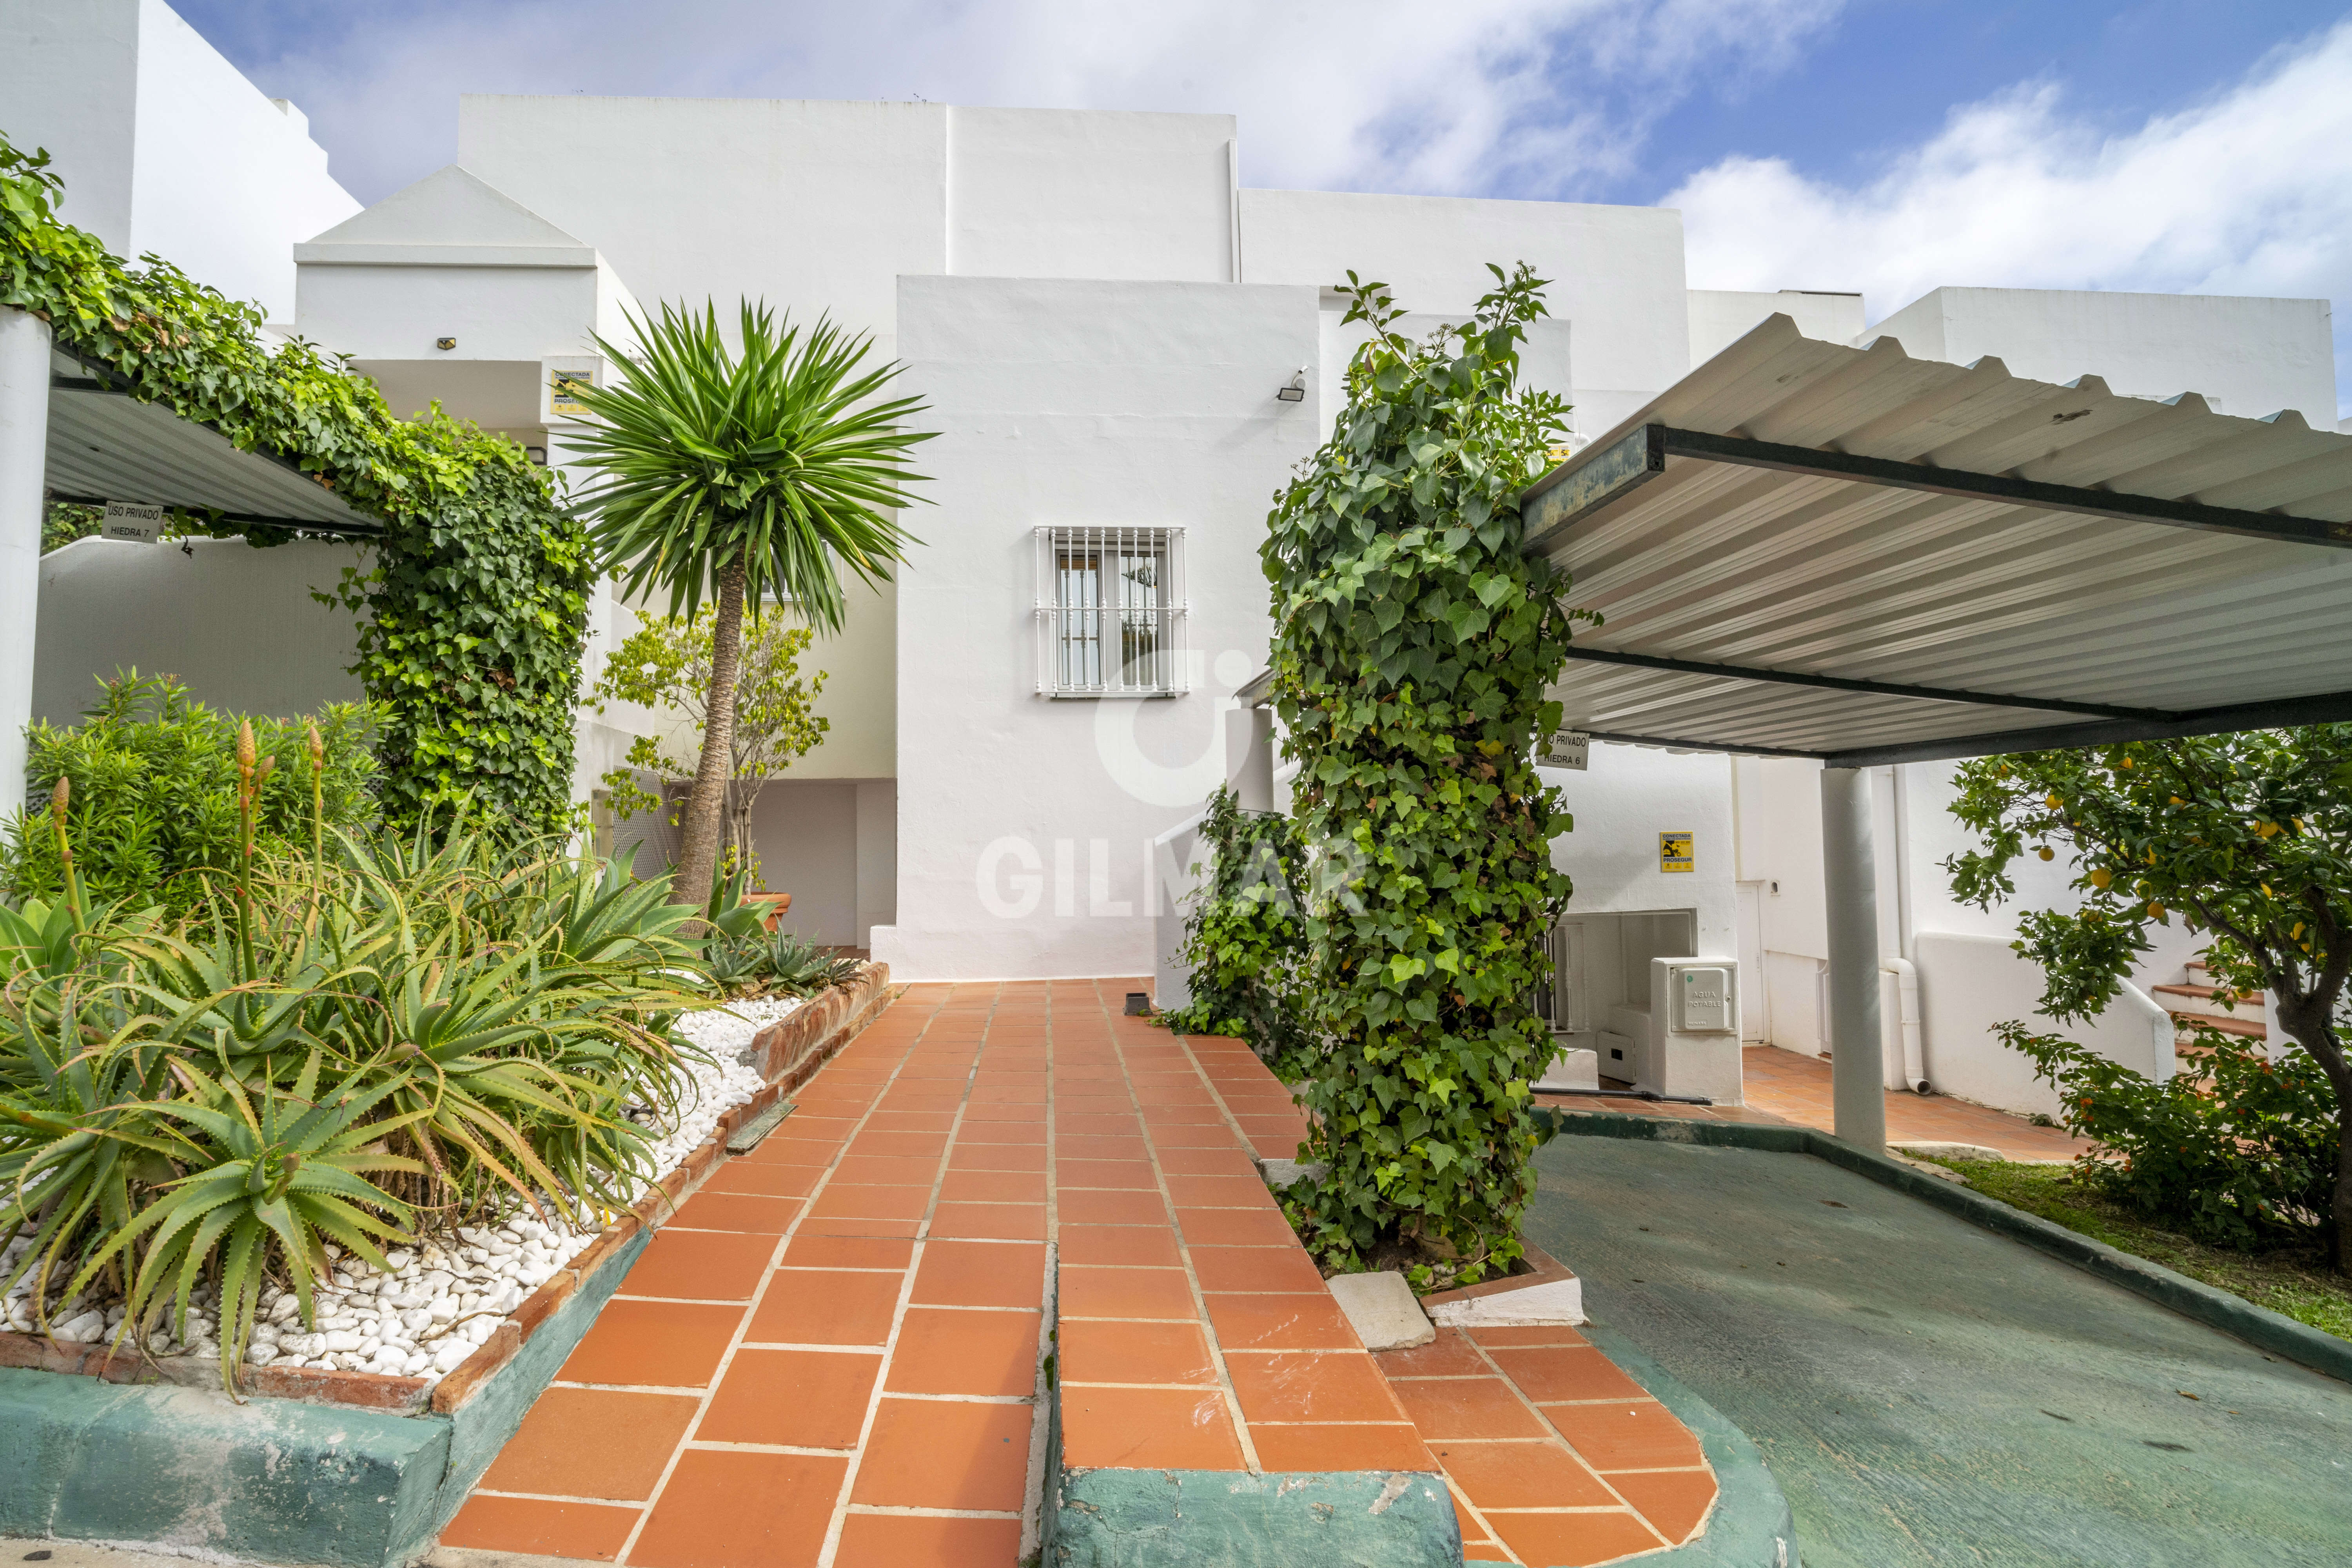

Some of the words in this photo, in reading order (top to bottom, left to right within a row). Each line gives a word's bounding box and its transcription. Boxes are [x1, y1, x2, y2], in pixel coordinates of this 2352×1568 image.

[108, 506, 124, 516] USO
[125, 507, 159, 520] PRIVADO
[111, 526, 141, 537] HIEDRA
[1556, 735, 1586, 747] PRIVADO
[1544, 754, 1572, 764] HIEDRA
